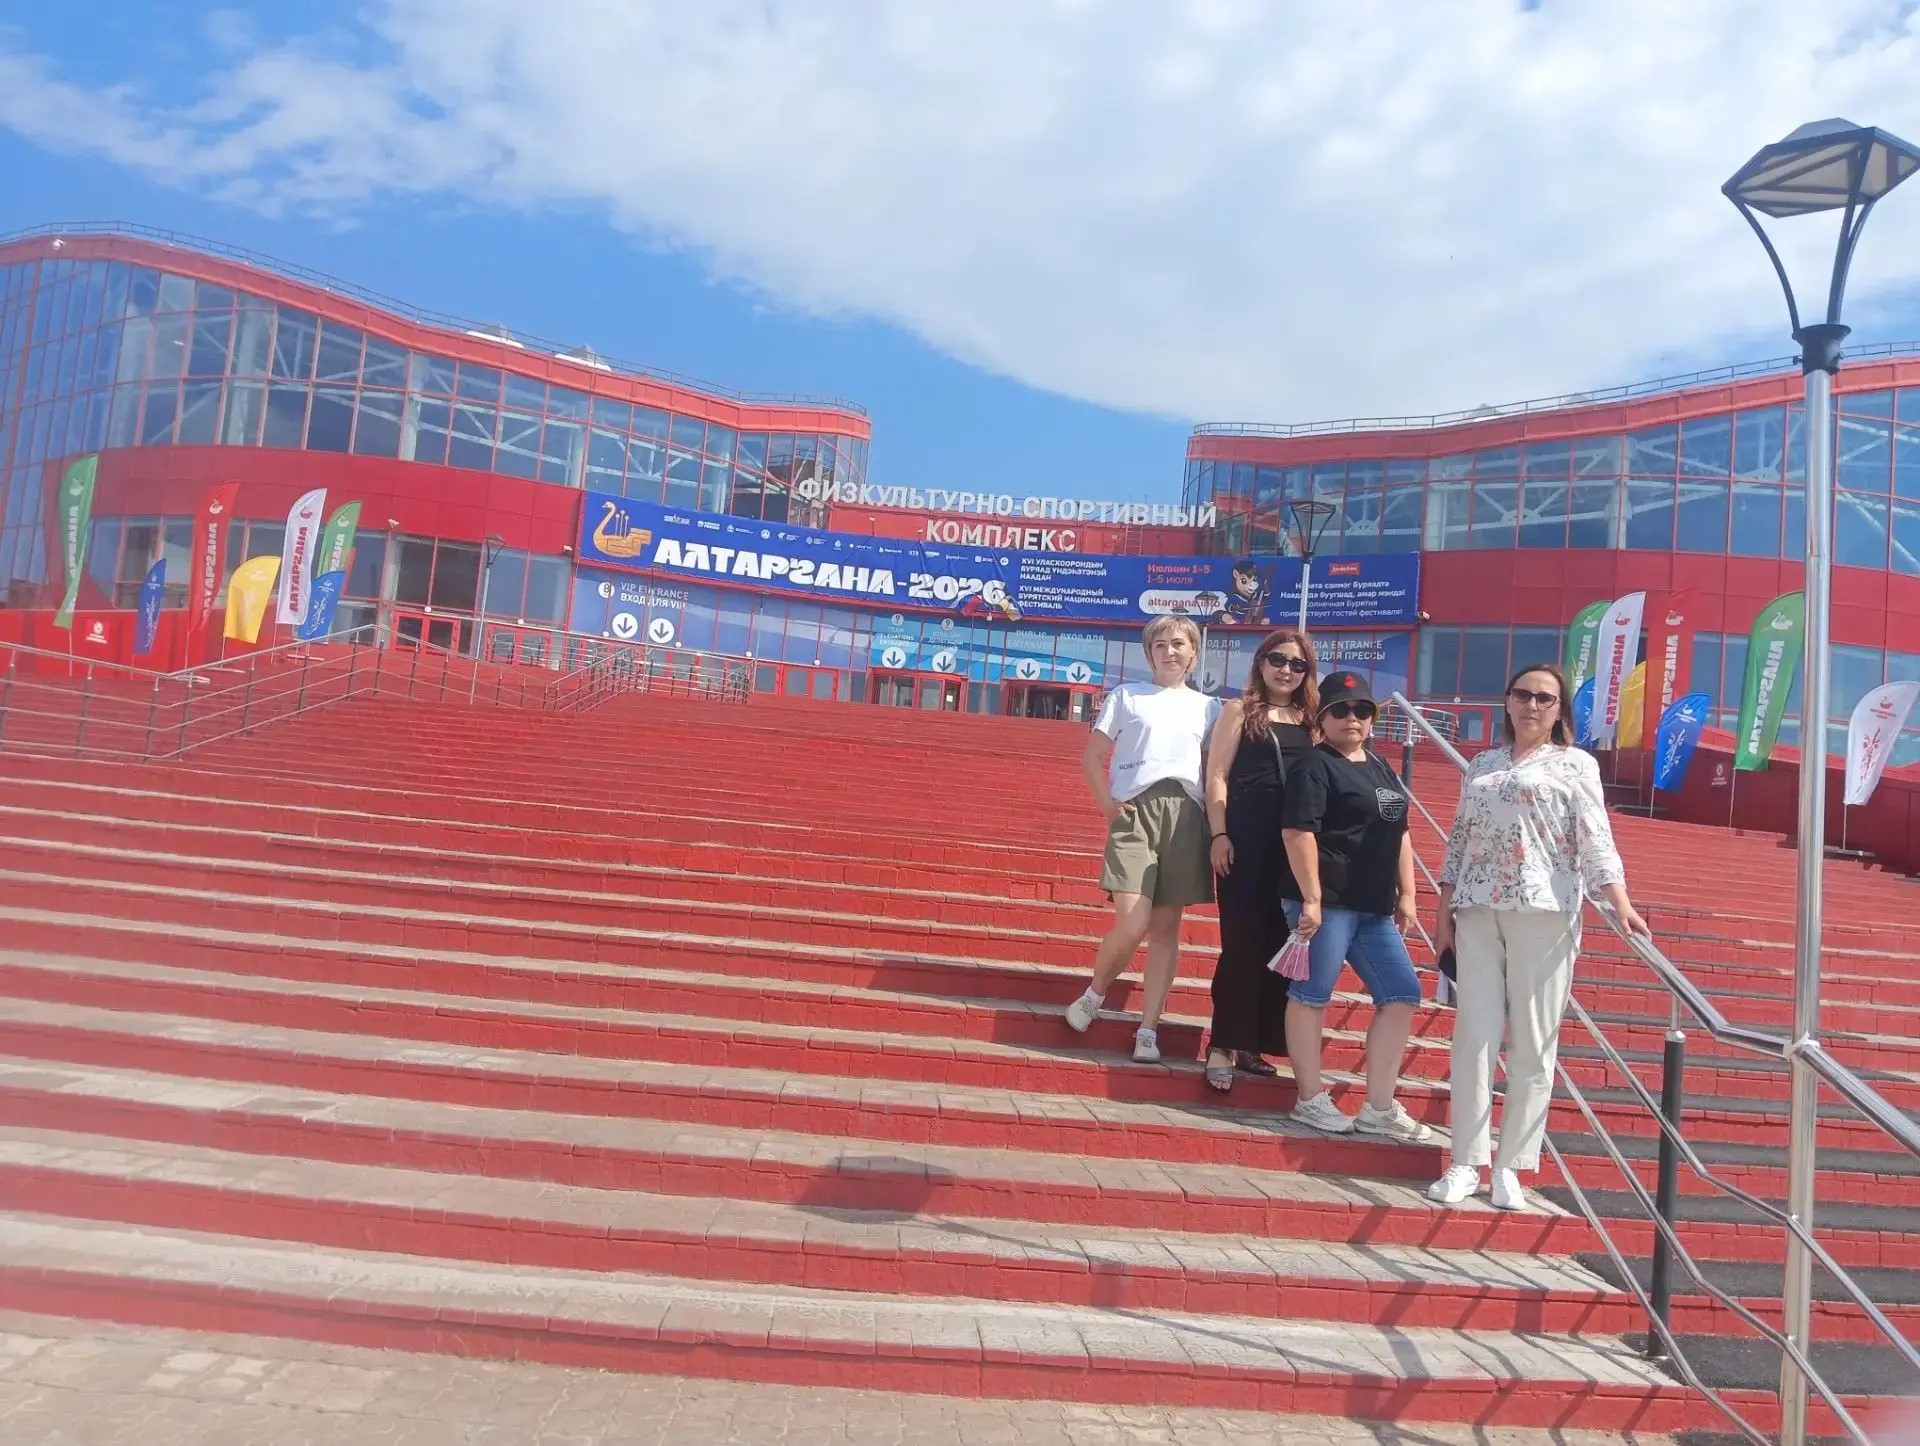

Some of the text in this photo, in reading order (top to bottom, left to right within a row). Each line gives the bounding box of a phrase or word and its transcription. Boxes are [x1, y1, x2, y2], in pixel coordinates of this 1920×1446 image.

[799, 478, 1217, 528] ФИЗКУЛЬТУРНО-СПОРТИВНЫЙ
[926, 520, 1077, 552] КОМПЛЕКС
[1020, 573, 1051, 581] НААДАН
[621, 582, 636, 592] VIP
[1033, 586, 1103, 596] МЕЖДУНАРОДНЫЙ
[620, 593, 646, 605] ВХОД
[648, 596, 670, 607] ДЛЯ
[1018, 592, 1128, 605] БУРЯТСКИЙ НАЦИОНАЛЬНЫЙ
[1018, 600, 1062, 609] ФЕСТИВАЛЬ
[1331, 640, 1384, 649] ENTRANCE
